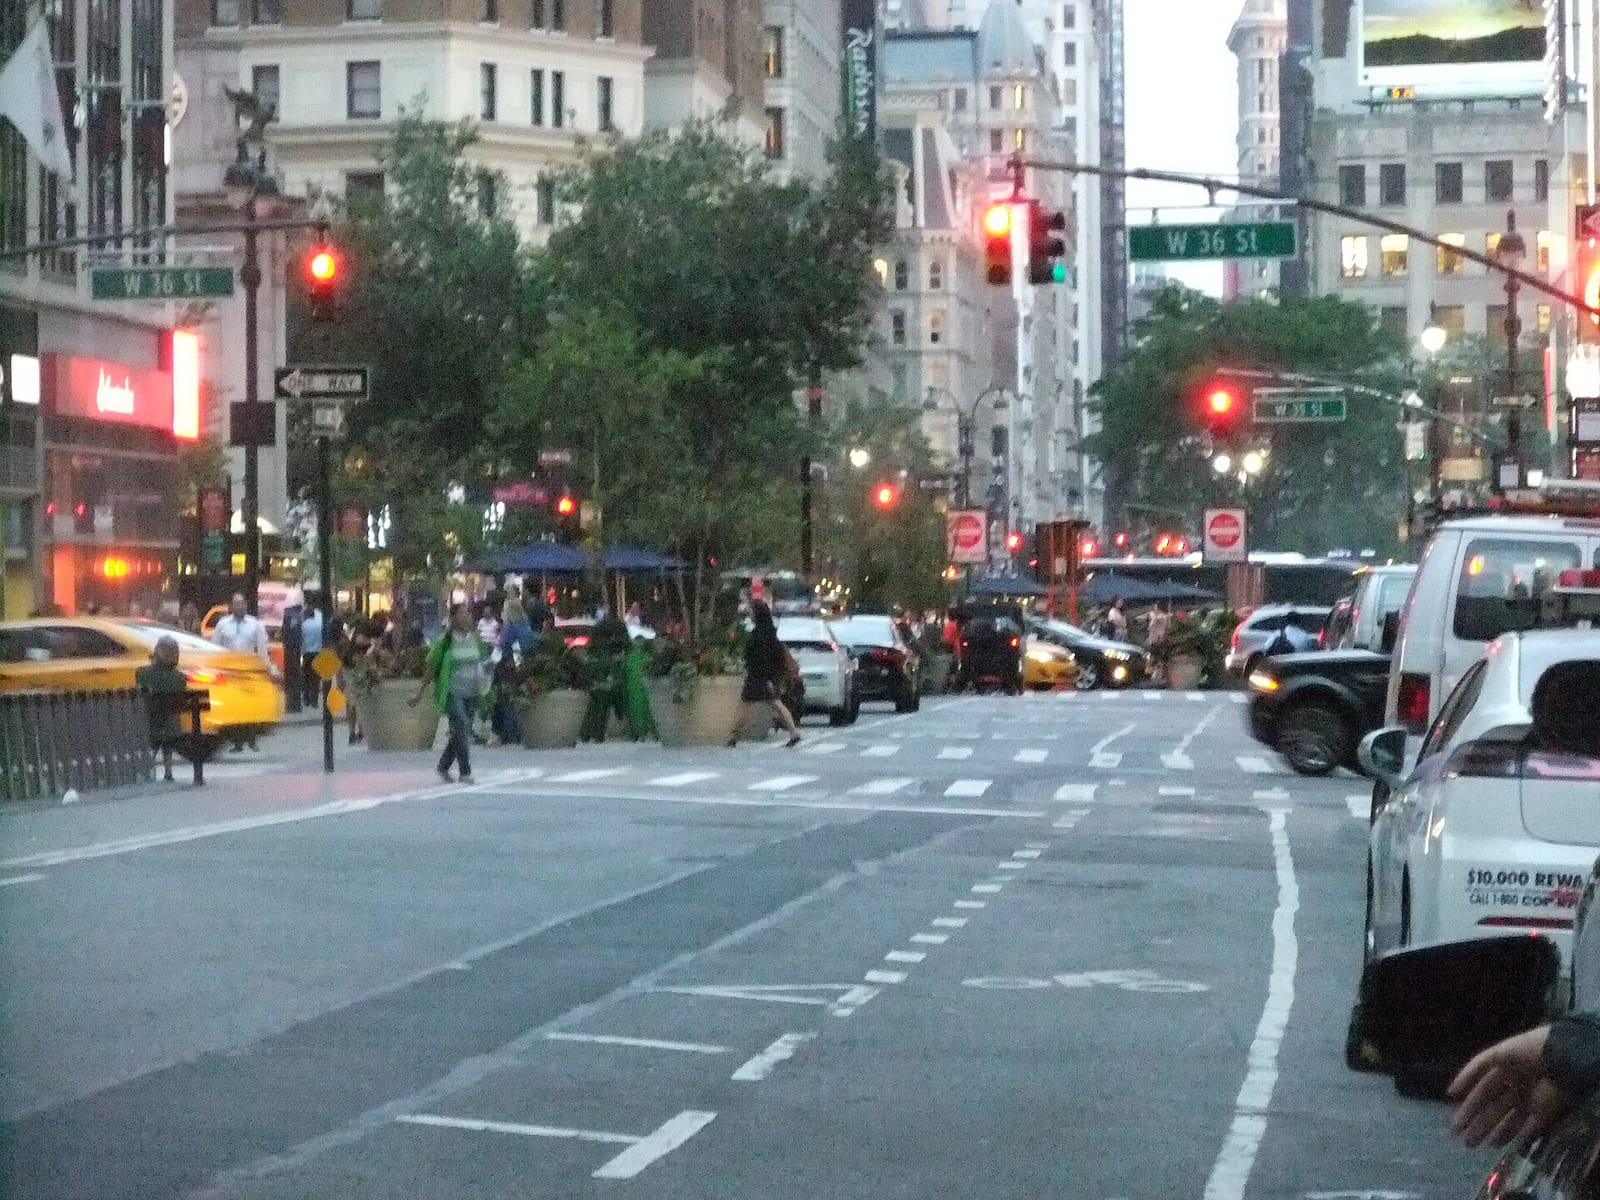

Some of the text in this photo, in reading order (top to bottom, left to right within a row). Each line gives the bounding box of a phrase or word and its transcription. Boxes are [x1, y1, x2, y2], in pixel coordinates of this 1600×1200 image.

[1168, 231, 1188, 254] W
[1199, 230, 1225, 254] 36
[124, 272, 141, 296] W
[1467, 868, 1530, 886] $10,000
